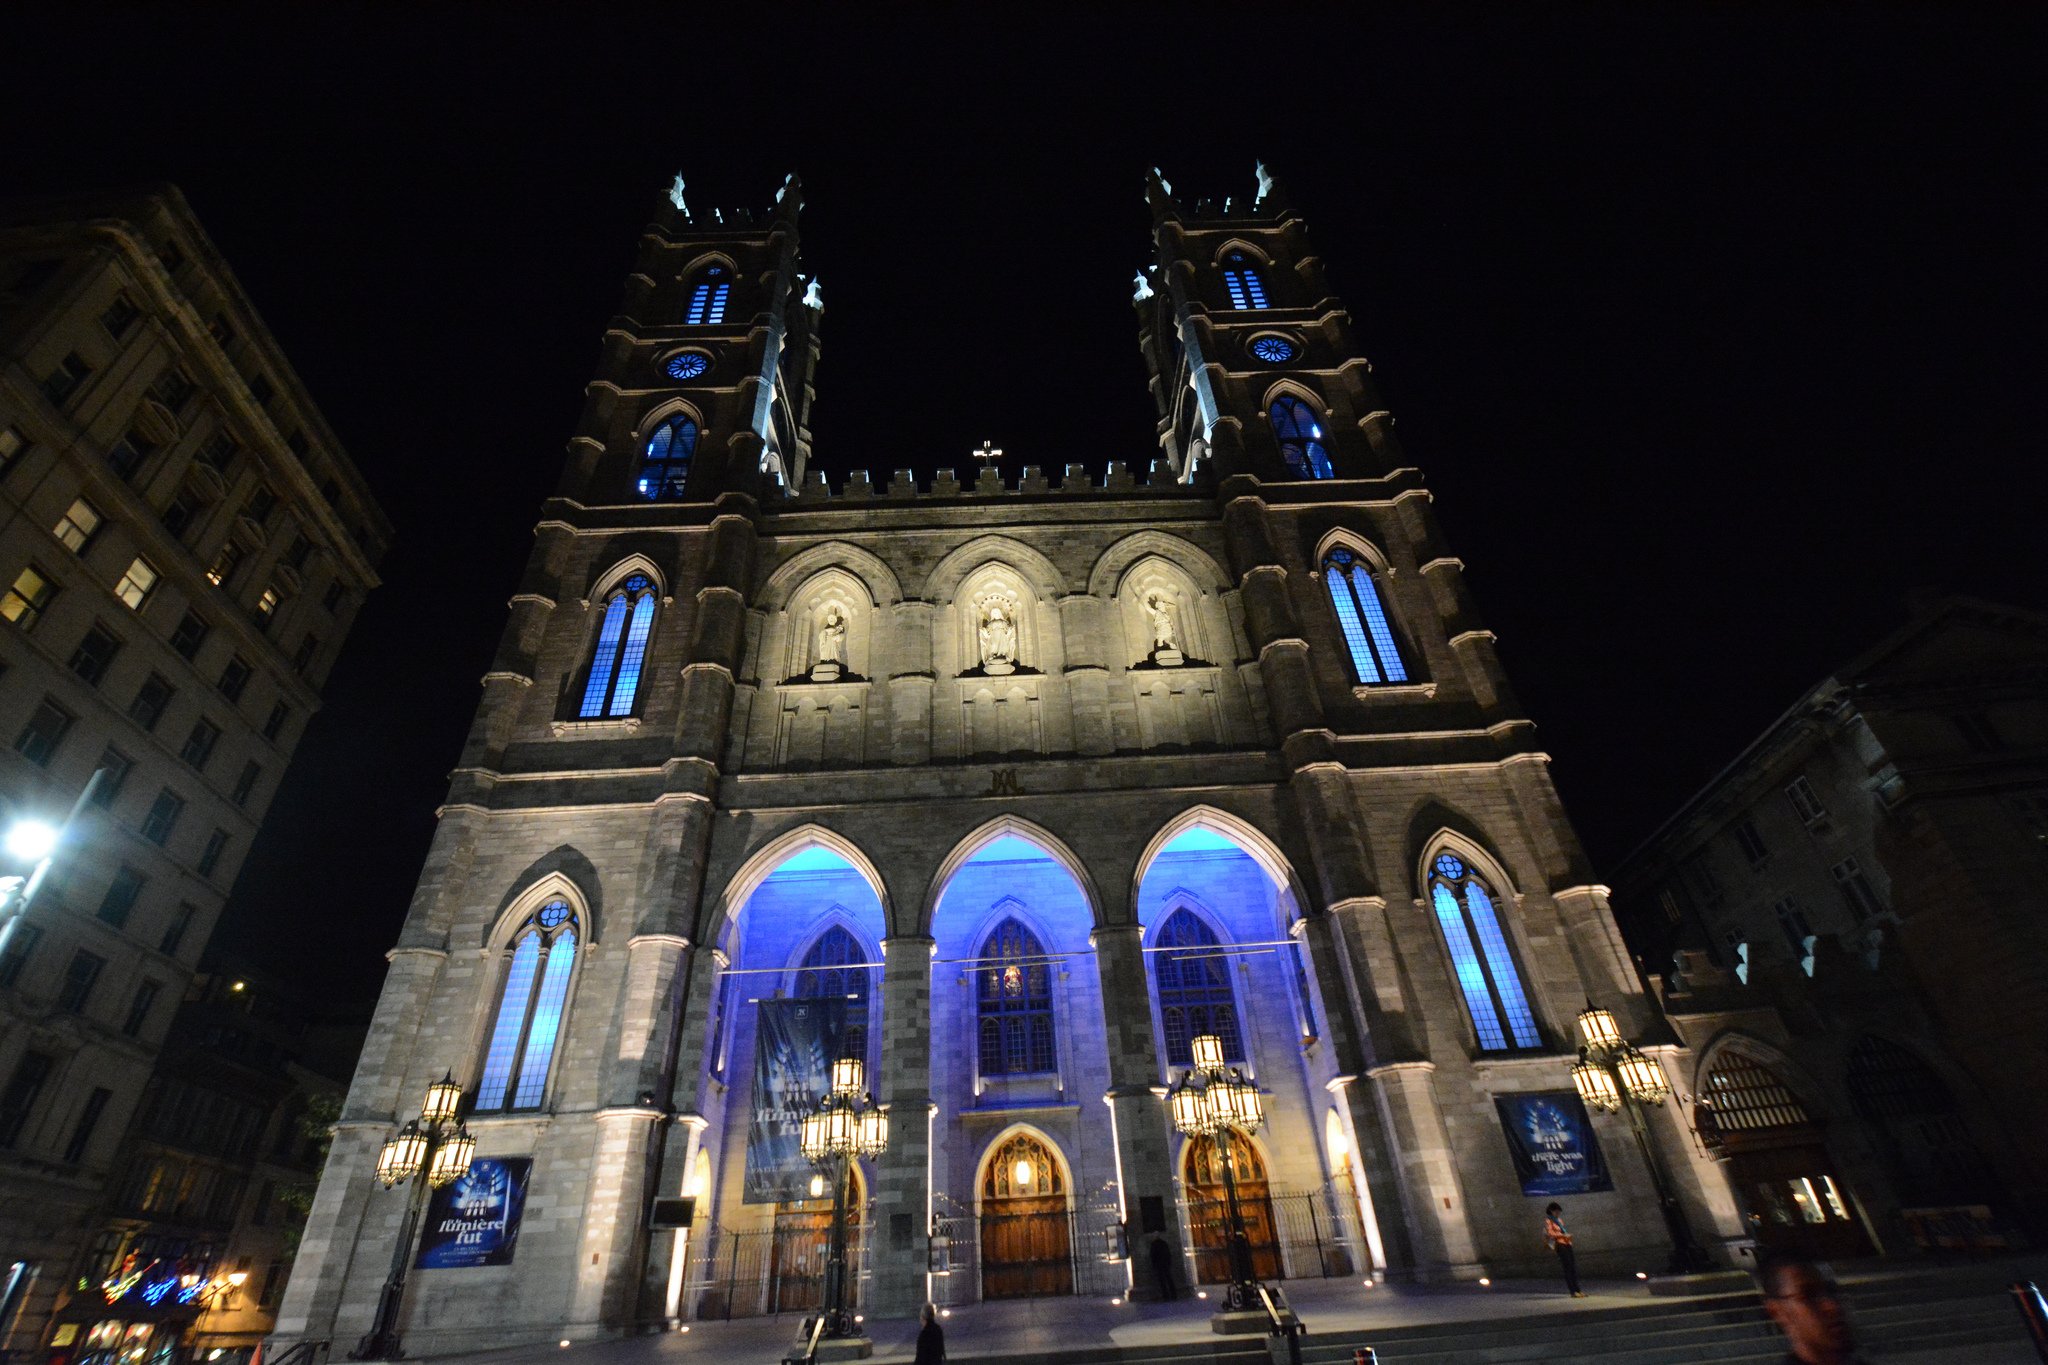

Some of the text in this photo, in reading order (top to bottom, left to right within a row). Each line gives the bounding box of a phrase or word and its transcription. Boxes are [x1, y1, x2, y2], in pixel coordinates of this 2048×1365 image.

[779, 1120, 802, 1136] fu
[1546, 1160, 1576, 1175] light
[438, 1218, 504, 1232] lumière
[455, 1230, 483, 1244] fut
